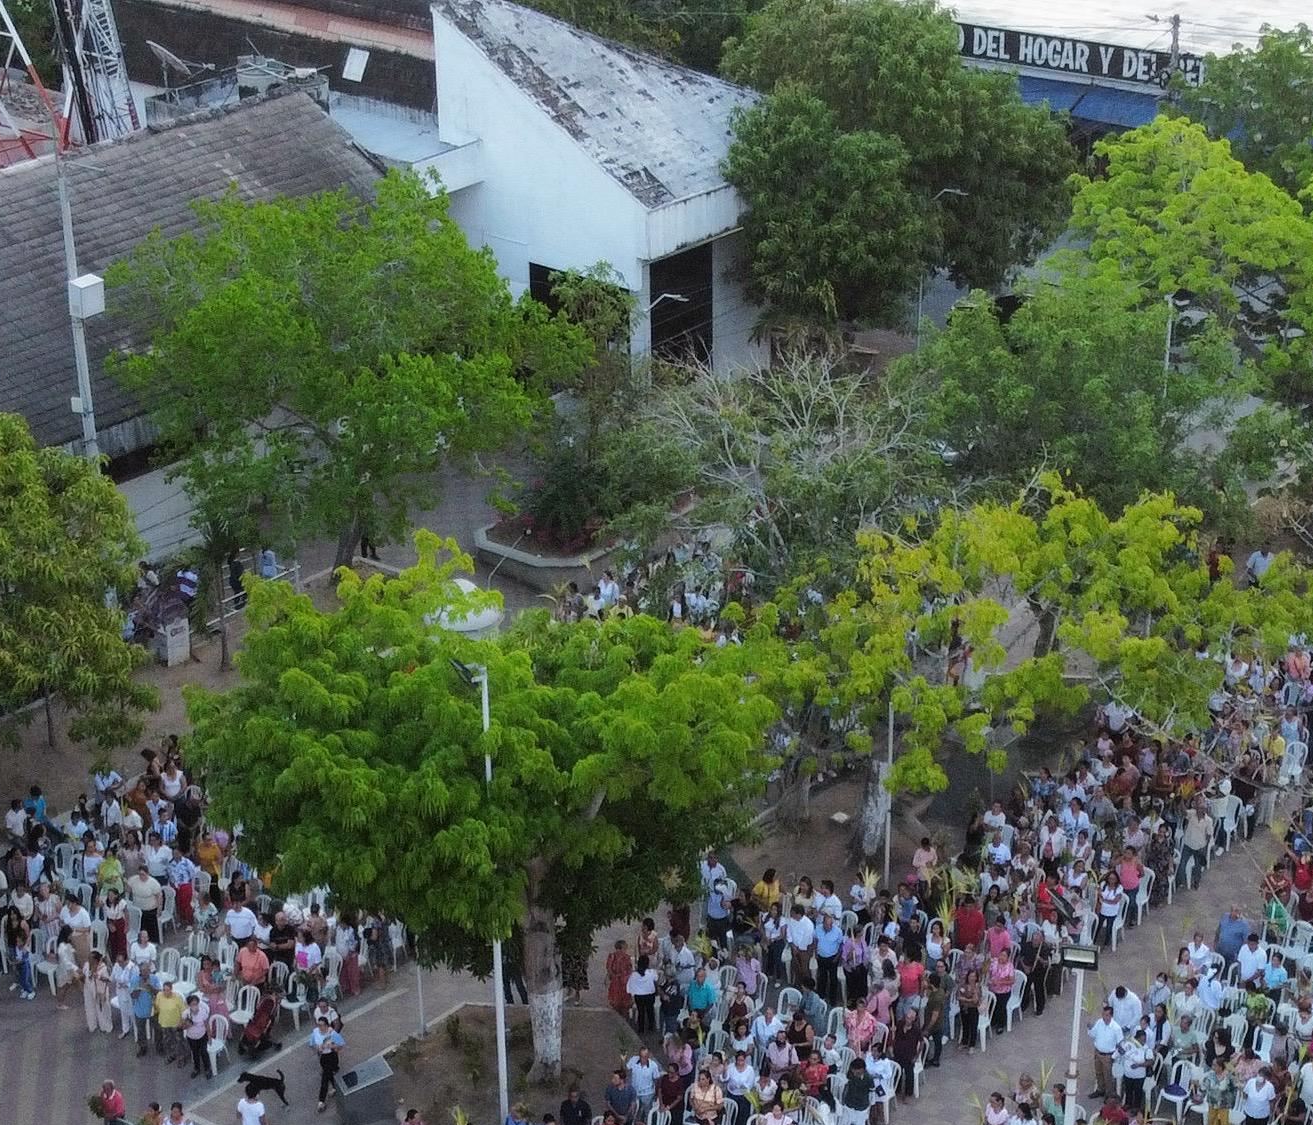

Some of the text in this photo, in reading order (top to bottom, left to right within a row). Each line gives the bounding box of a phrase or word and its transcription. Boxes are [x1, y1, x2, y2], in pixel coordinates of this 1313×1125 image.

[973, 27, 1010, 59] DEL
[1019, 34, 1090, 73] HOGAR
[1099, 45, 1115, 75] Y
